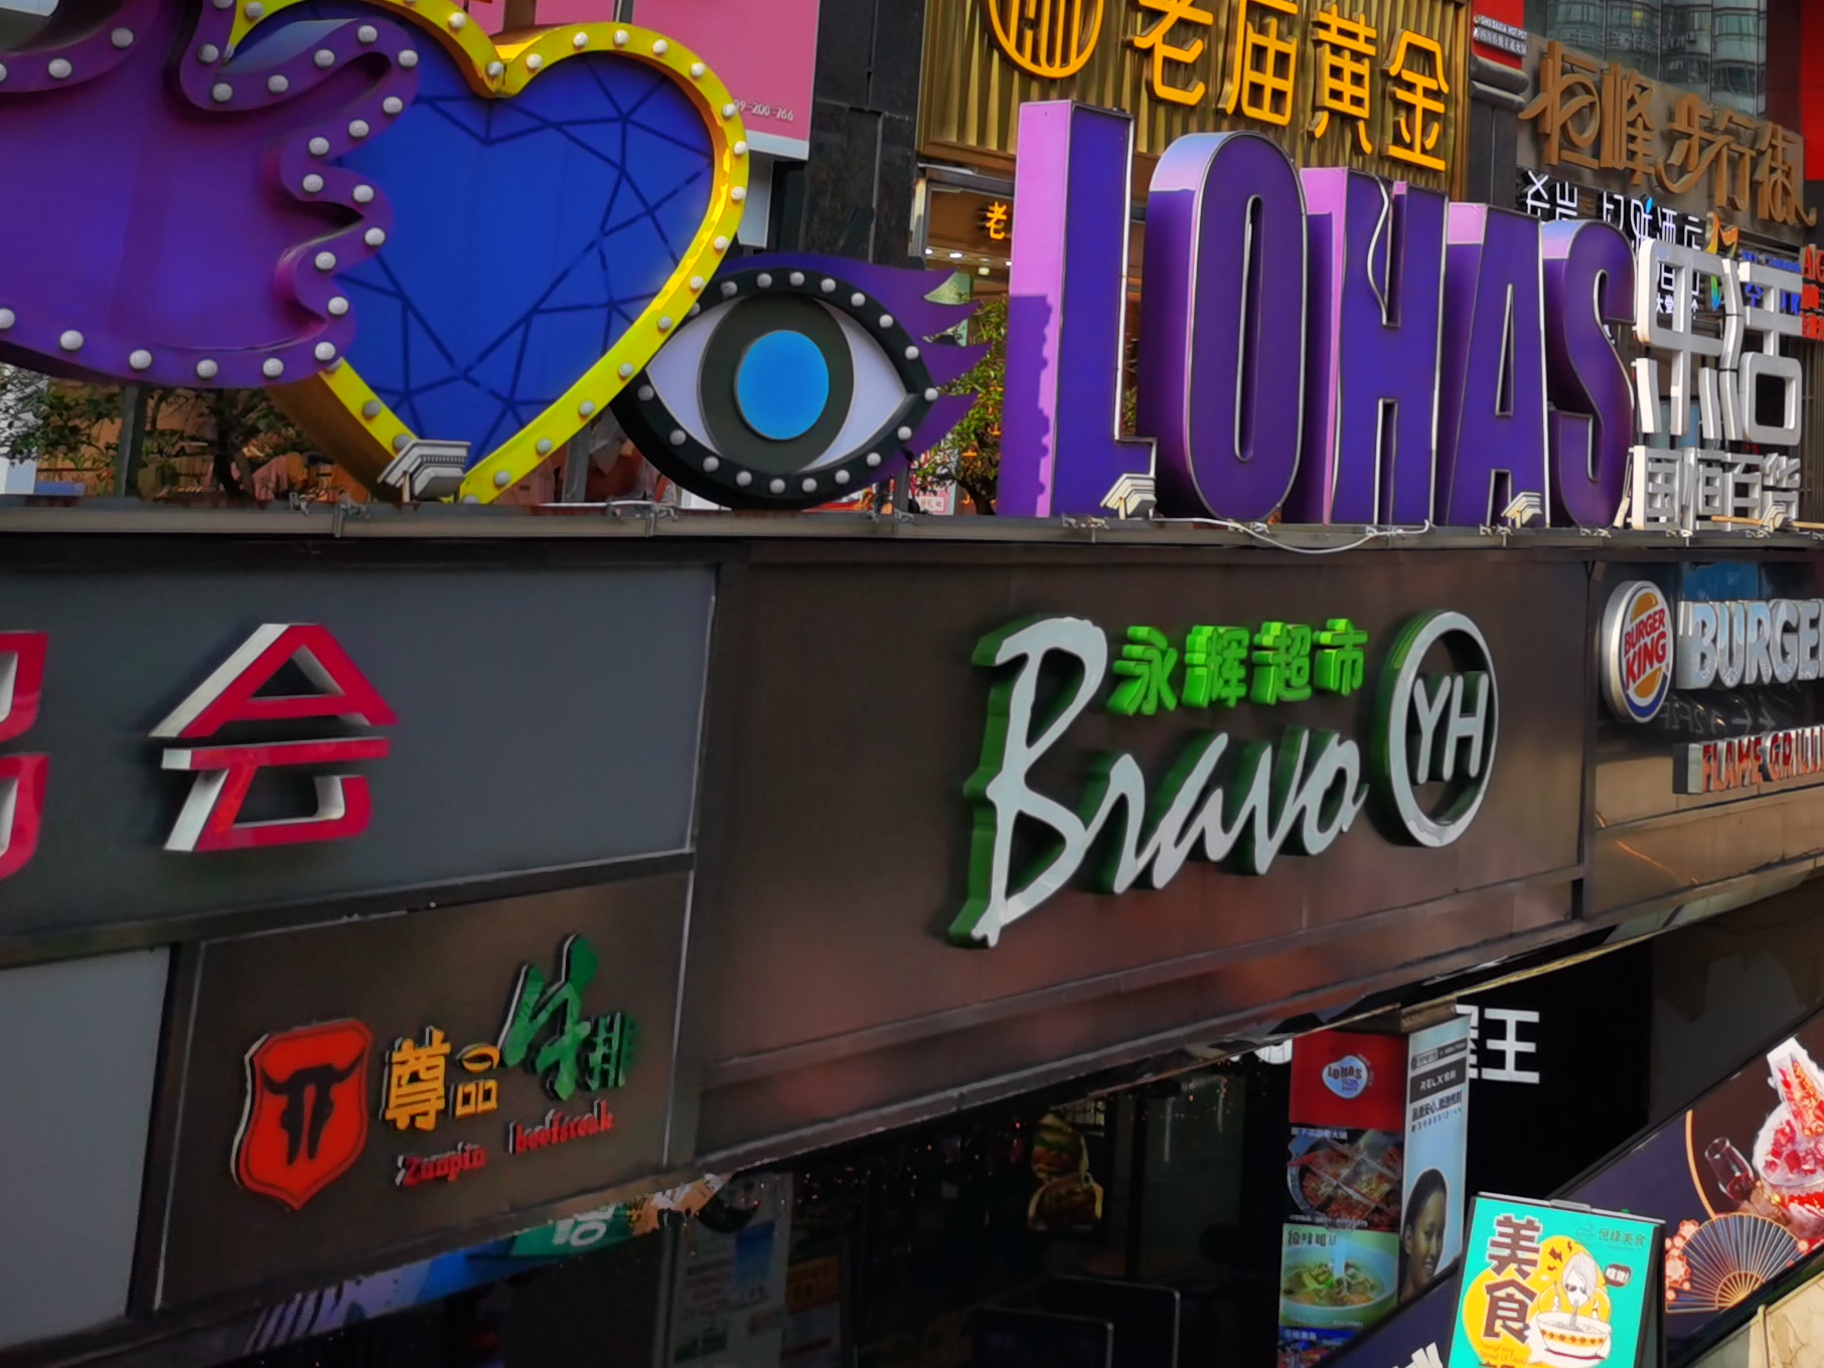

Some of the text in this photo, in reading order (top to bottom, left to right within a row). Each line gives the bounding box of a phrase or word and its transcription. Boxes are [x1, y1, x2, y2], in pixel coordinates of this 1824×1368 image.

[1518, 41, 1817, 228] 恒峰步行街
[985, 201, 1008, 241] 老
[1001, 99, 1634, 526] LOHAS
[1107, 618, 1369, 717] 永辉超市
[1624, 608, 1666, 658] BURGER
[1625, 630, 1667, 691] KING
[1412, 670, 1491, 787] YH
[1702, 732, 1763, 792] FLAME
[949, 613, 1370, 948] Bravo
[1327, 1066, 1363, 1080] LOHAS
[397, 1142, 488, 1187] Zunpin
[1482, 1212, 1543, 1346] 美食
